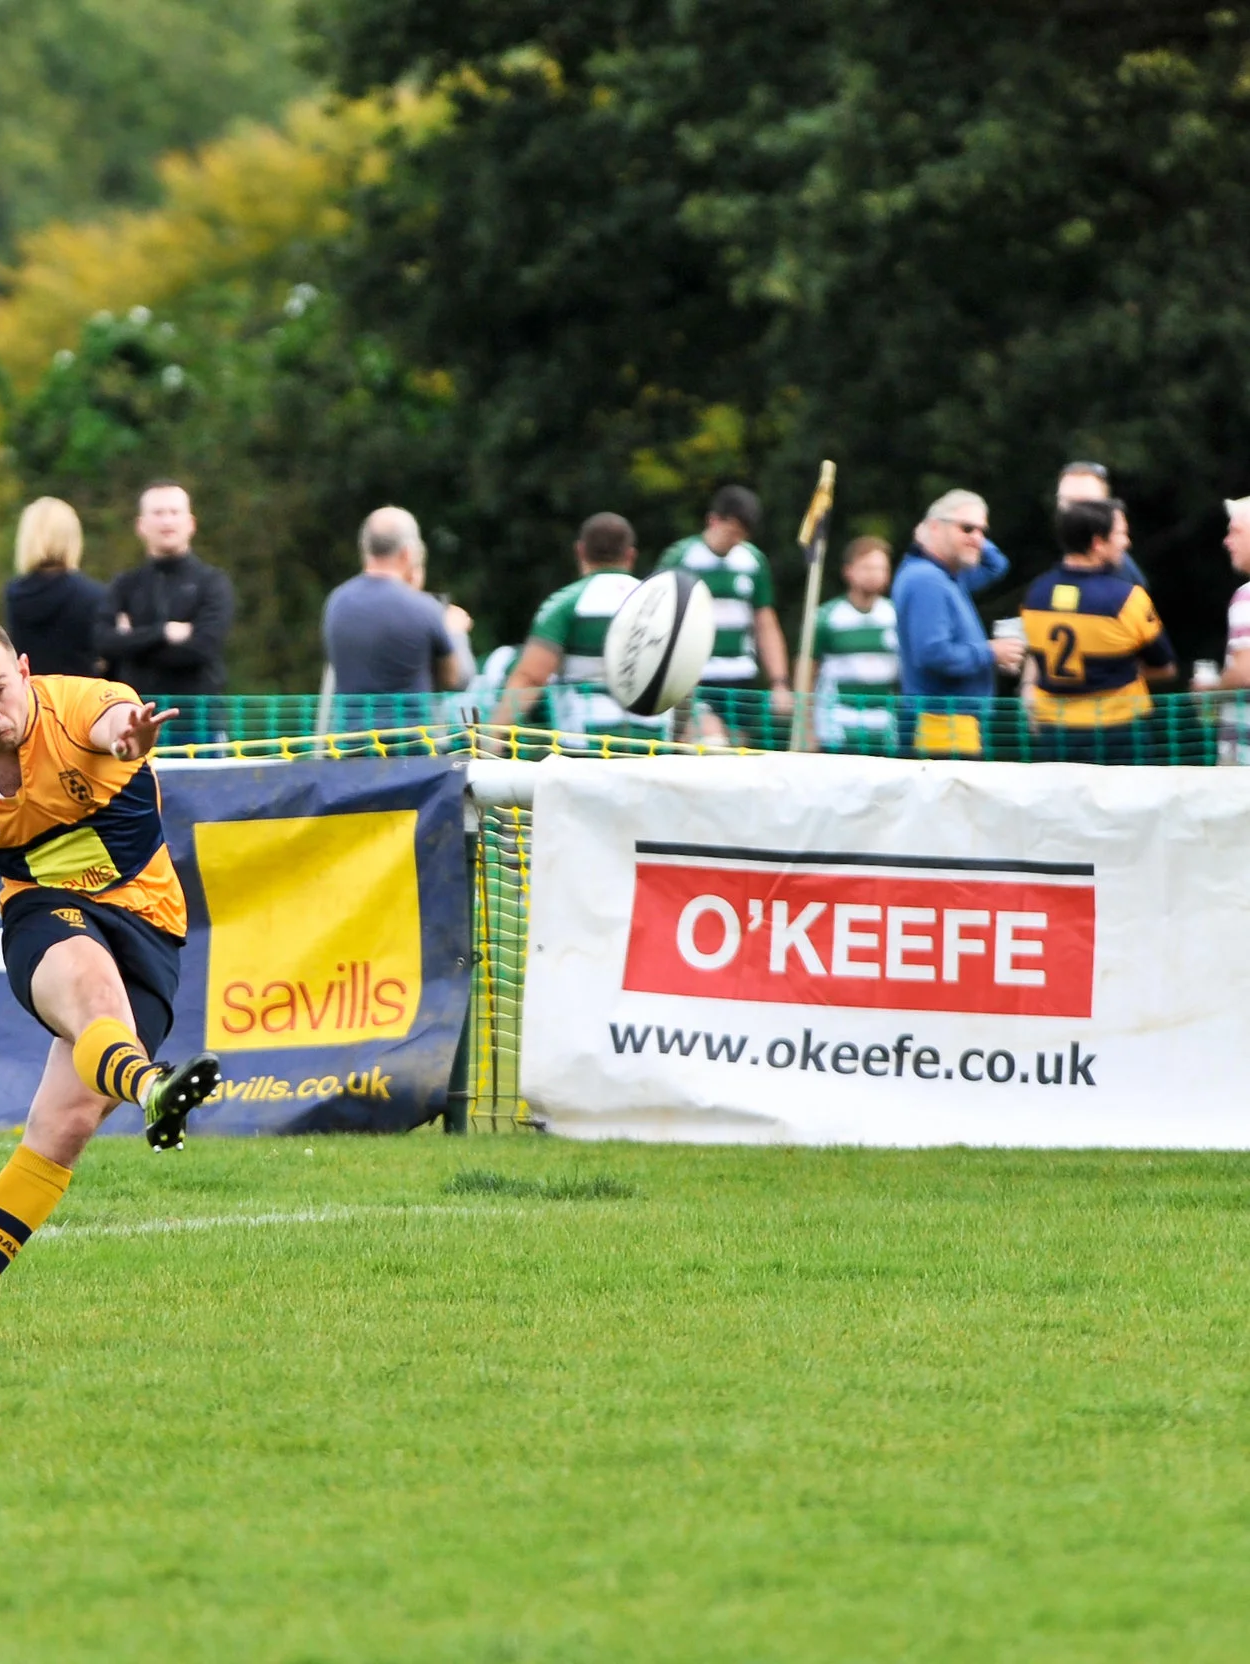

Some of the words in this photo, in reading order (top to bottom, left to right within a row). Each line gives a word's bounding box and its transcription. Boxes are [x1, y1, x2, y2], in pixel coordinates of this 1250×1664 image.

[1049, 624, 1077, 678] 2
[61, 865, 115, 889] vills
[676, 893, 1048, 987] O'KEEFE
[220, 961, 408, 1035] savills
[608, 1021, 1097, 1087] www.okeefe.co.uk
[202, 1065, 393, 1106] avills.co.uk
